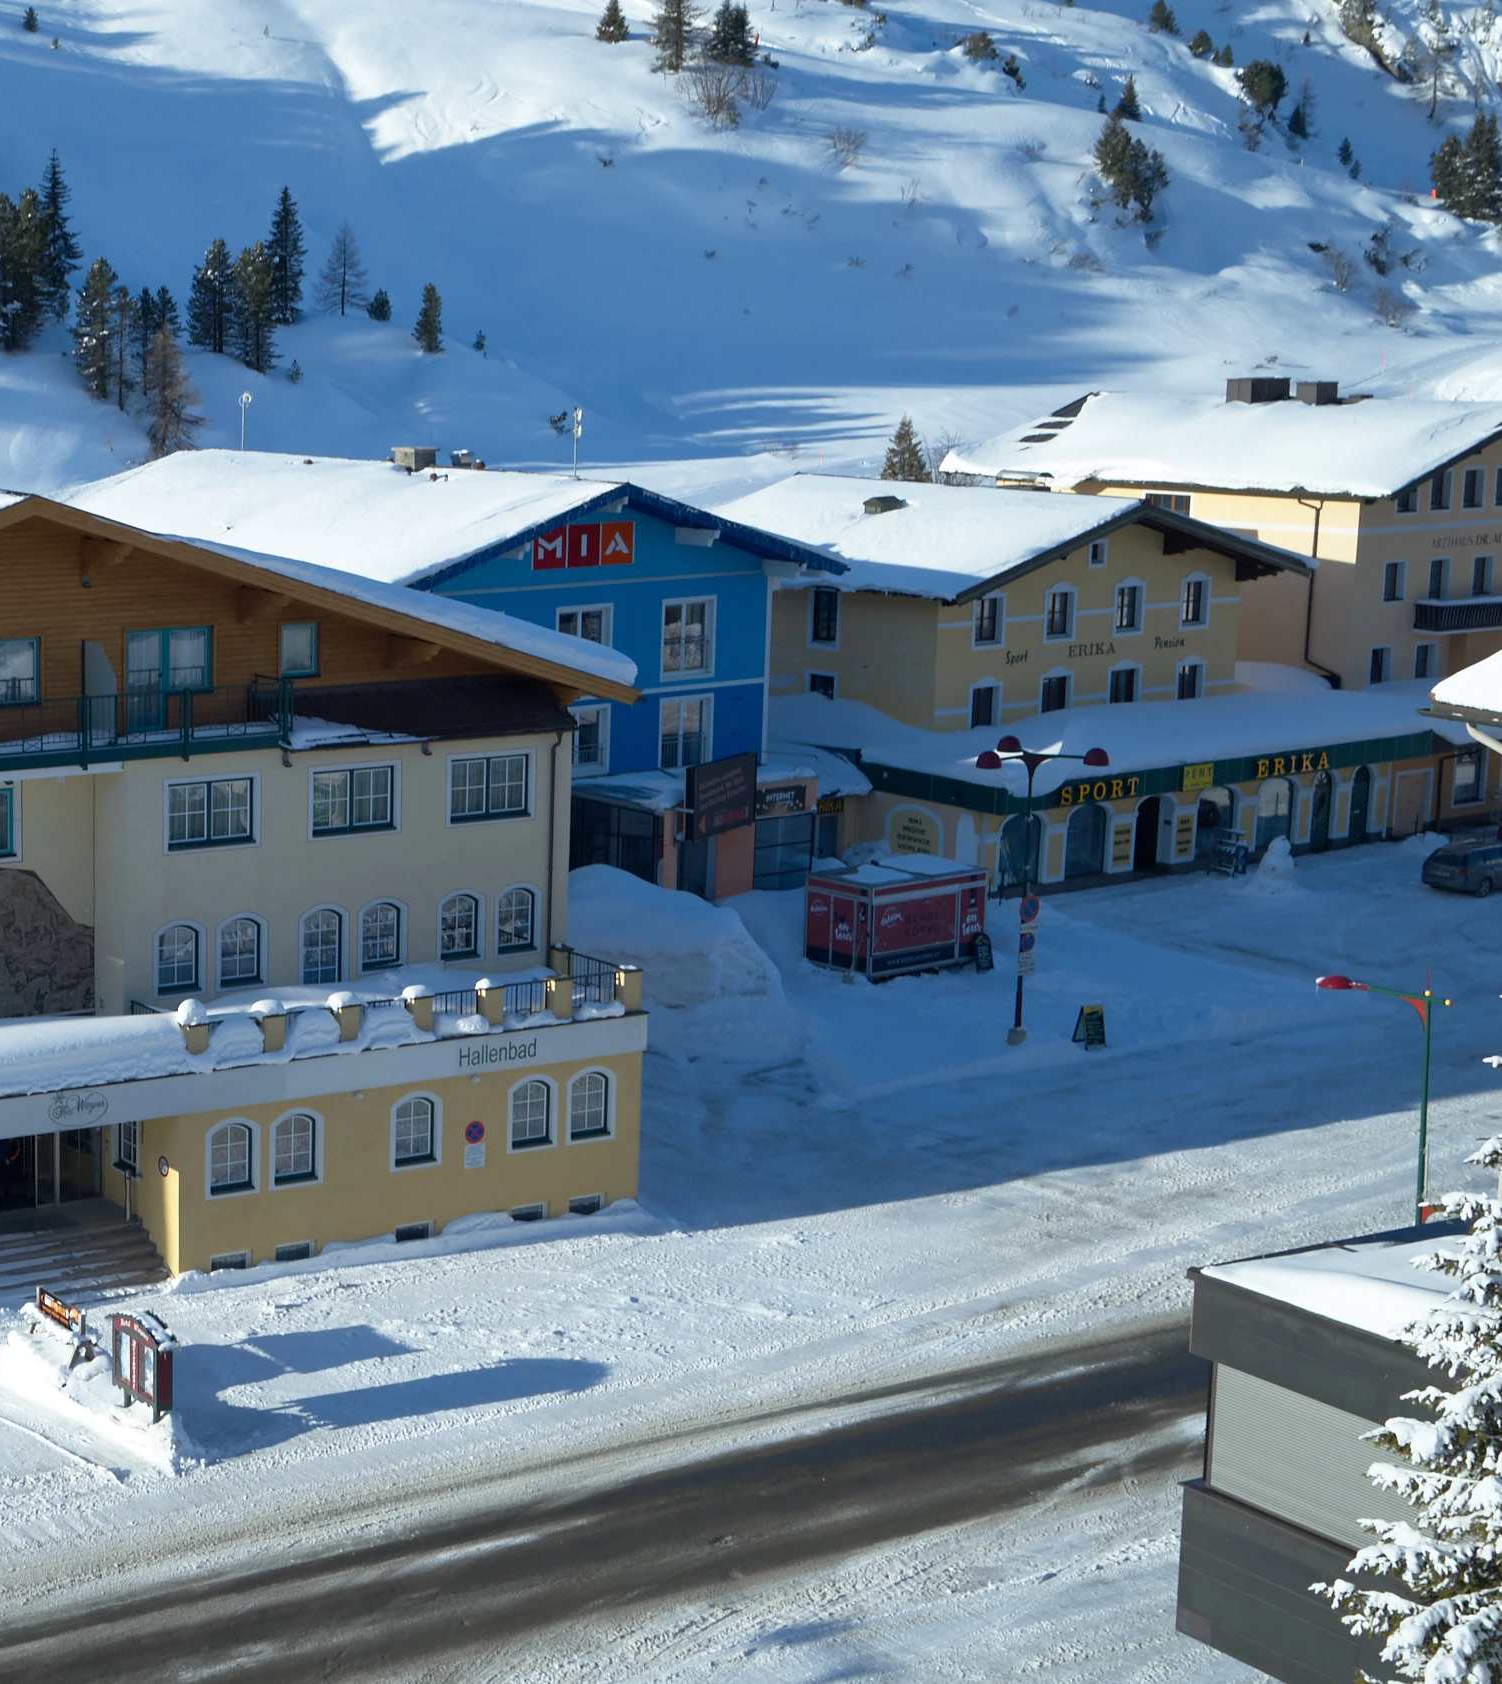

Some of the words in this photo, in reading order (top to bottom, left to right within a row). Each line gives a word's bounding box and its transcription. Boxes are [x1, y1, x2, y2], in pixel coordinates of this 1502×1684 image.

[537, 531, 630, 560] MIA
[1005, 650, 1028, 666] Sport
[1068, 642, 1116, 658] ERIKA
[1154, 636, 1185, 649] Pension
[1256, 751, 1330, 779] ERIKA
[766, 791, 795, 802] INTERNET
[1060, 777, 1140, 806] SPORT
[897, 833, 931, 847] SERVICE
[902, 825, 926, 835] MODE
[459, 1038, 537, 1067] Hallenbad
